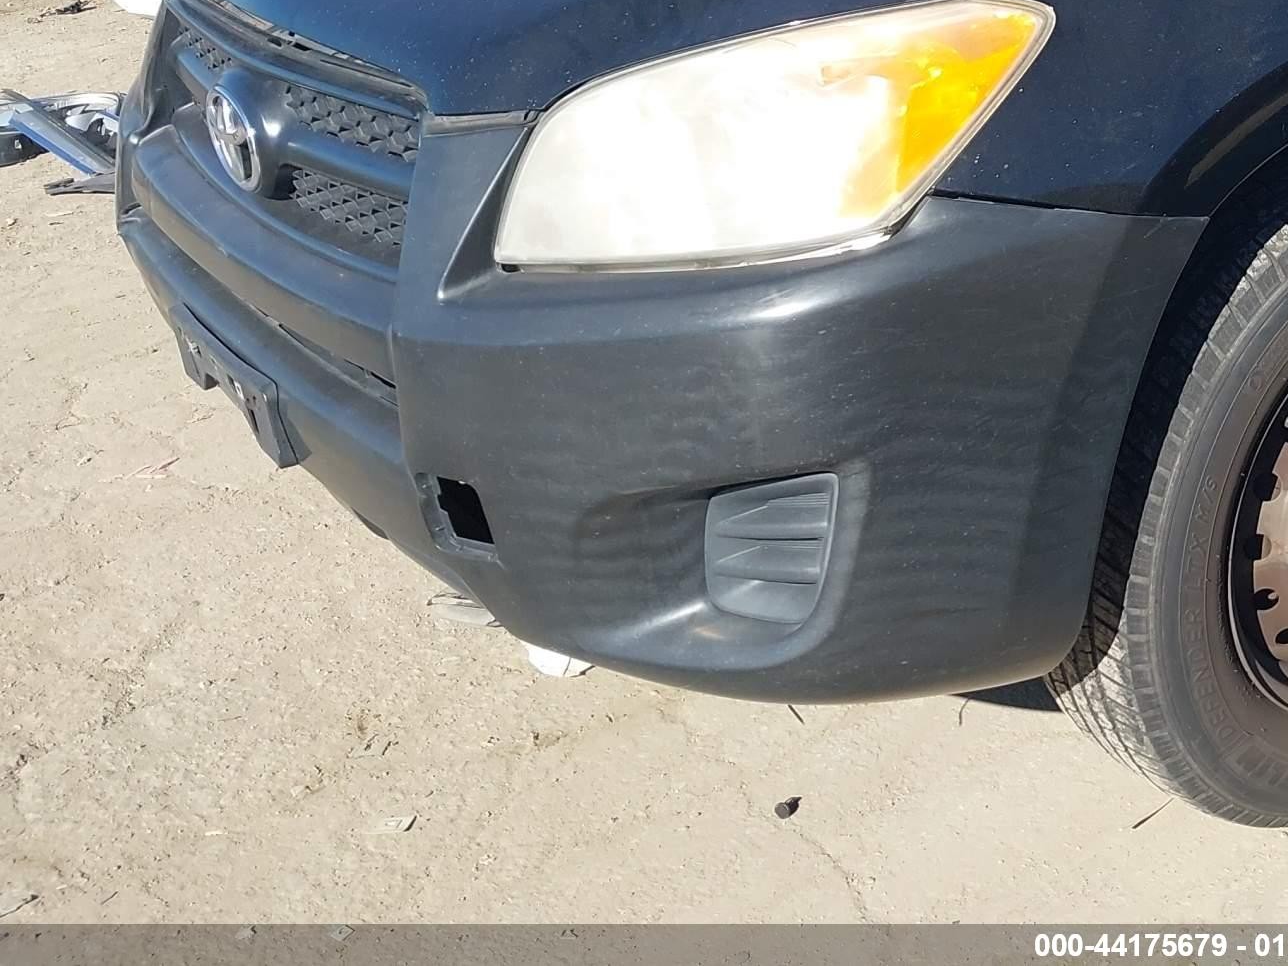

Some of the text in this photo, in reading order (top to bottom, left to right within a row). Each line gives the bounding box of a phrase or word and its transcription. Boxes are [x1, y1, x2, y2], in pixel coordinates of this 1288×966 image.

[1183, 475, 1238, 740] DEFENDER LTX M/S
